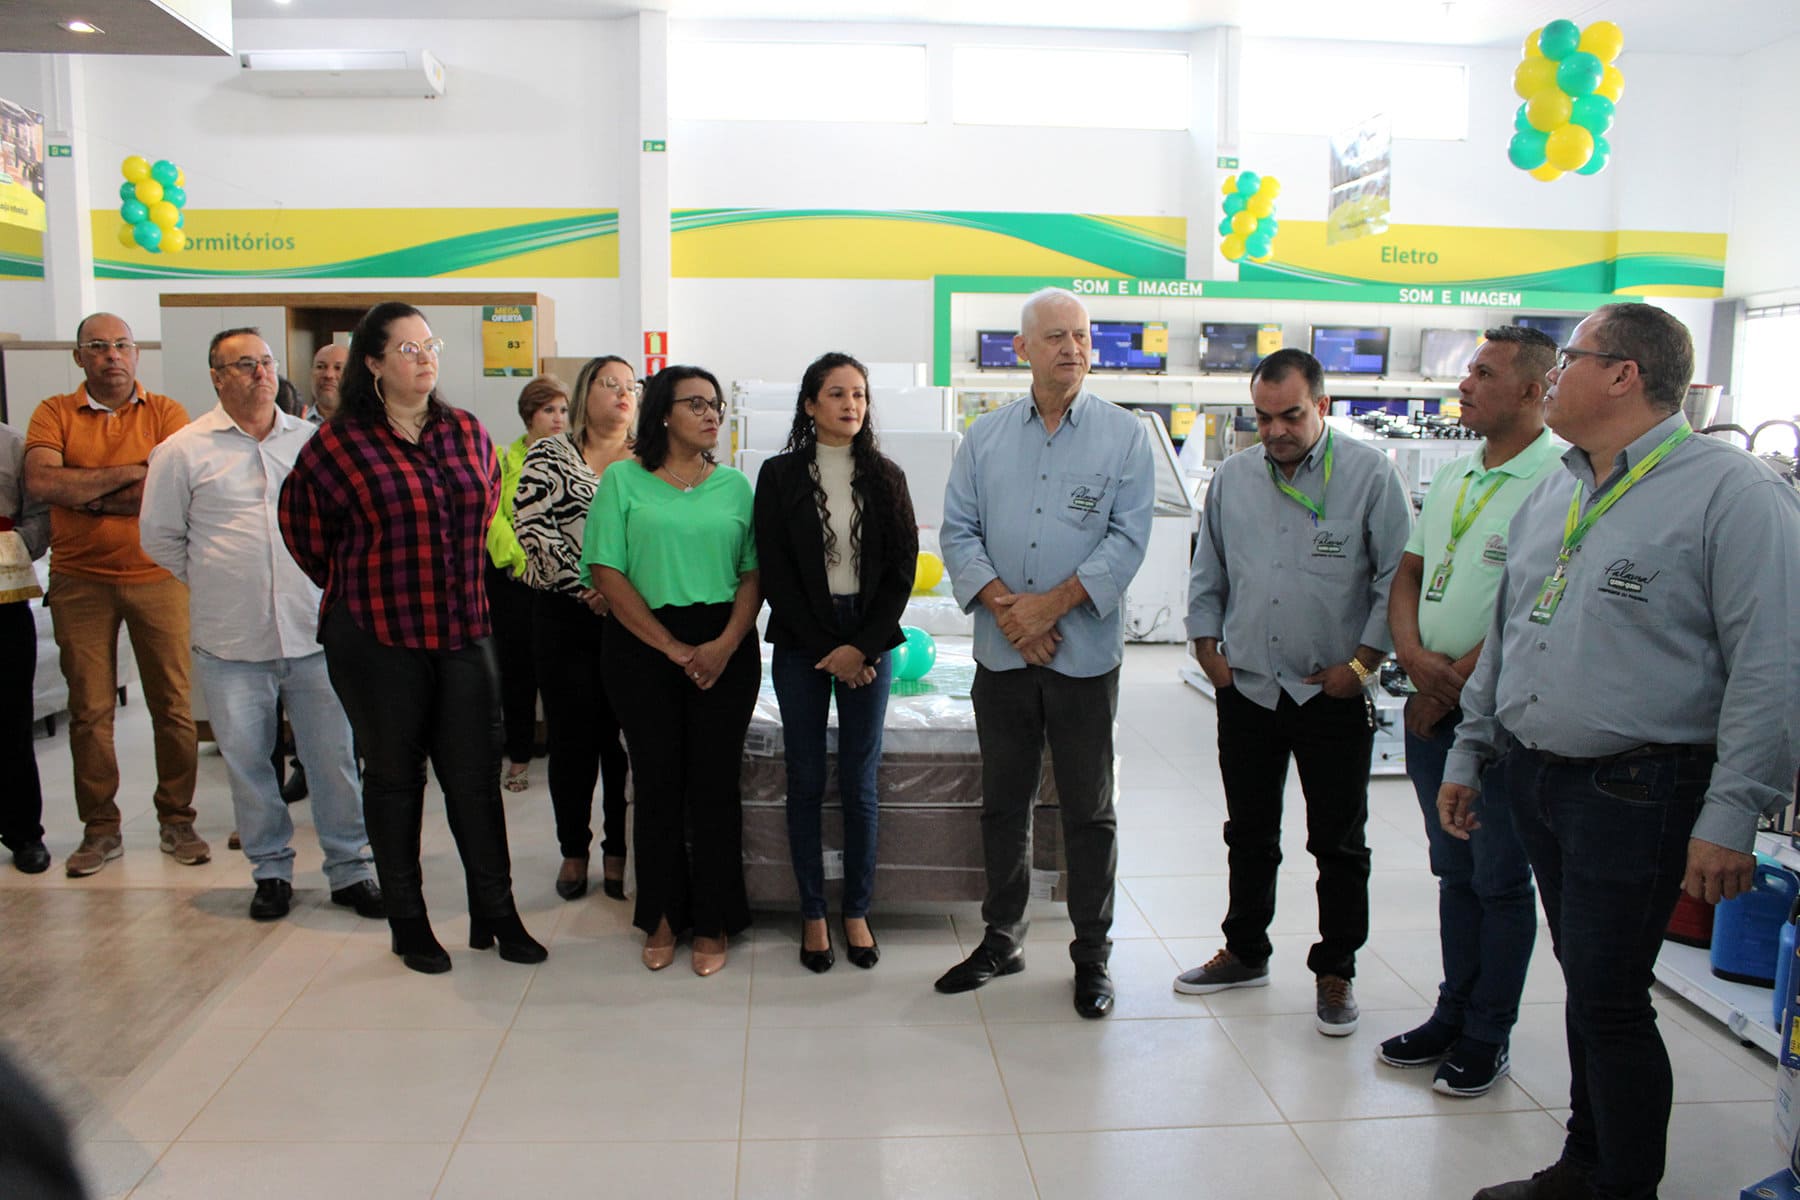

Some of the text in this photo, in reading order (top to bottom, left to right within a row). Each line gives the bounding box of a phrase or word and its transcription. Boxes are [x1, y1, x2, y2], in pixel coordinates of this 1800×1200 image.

[184, 231, 296, 251] ormitórios
[1381, 245, 1439, 264] Eletro
[1073, 279, 1203, 296] SOM E IMAGEM
[1399, 288, 1522, 306] SOM E IMAGEM
[492, 314, 523, 322] OFERTA
[507, 340, 520, 349] 83
